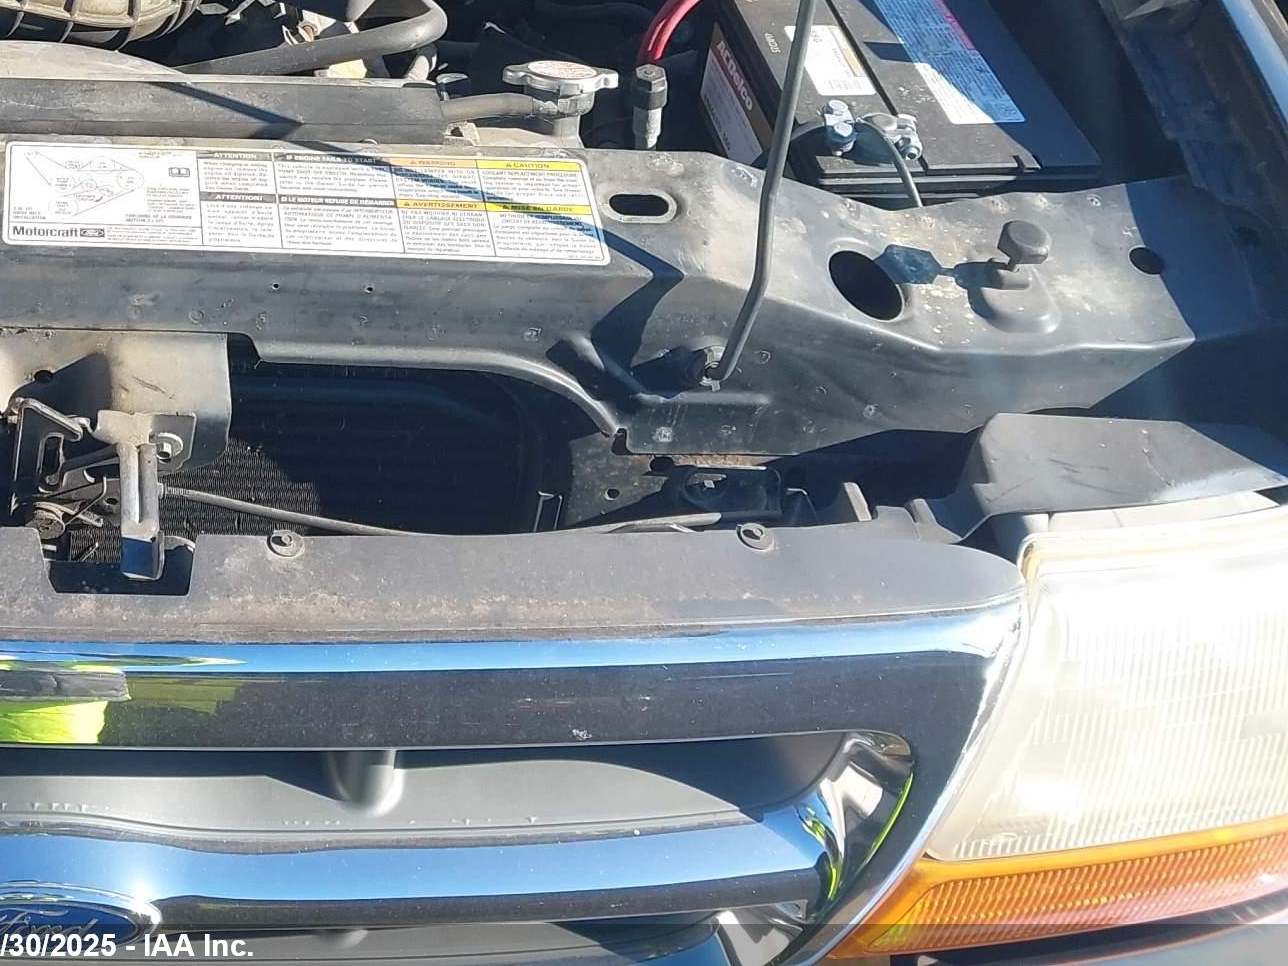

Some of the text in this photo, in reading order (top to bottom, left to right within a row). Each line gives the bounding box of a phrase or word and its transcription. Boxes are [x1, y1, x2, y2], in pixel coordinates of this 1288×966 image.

[716, 40, 753, 112] ACDelco
[413, 201, 478, 209] AVERTISSEMENT
[12, 225, 78, 238] Motorcraft
